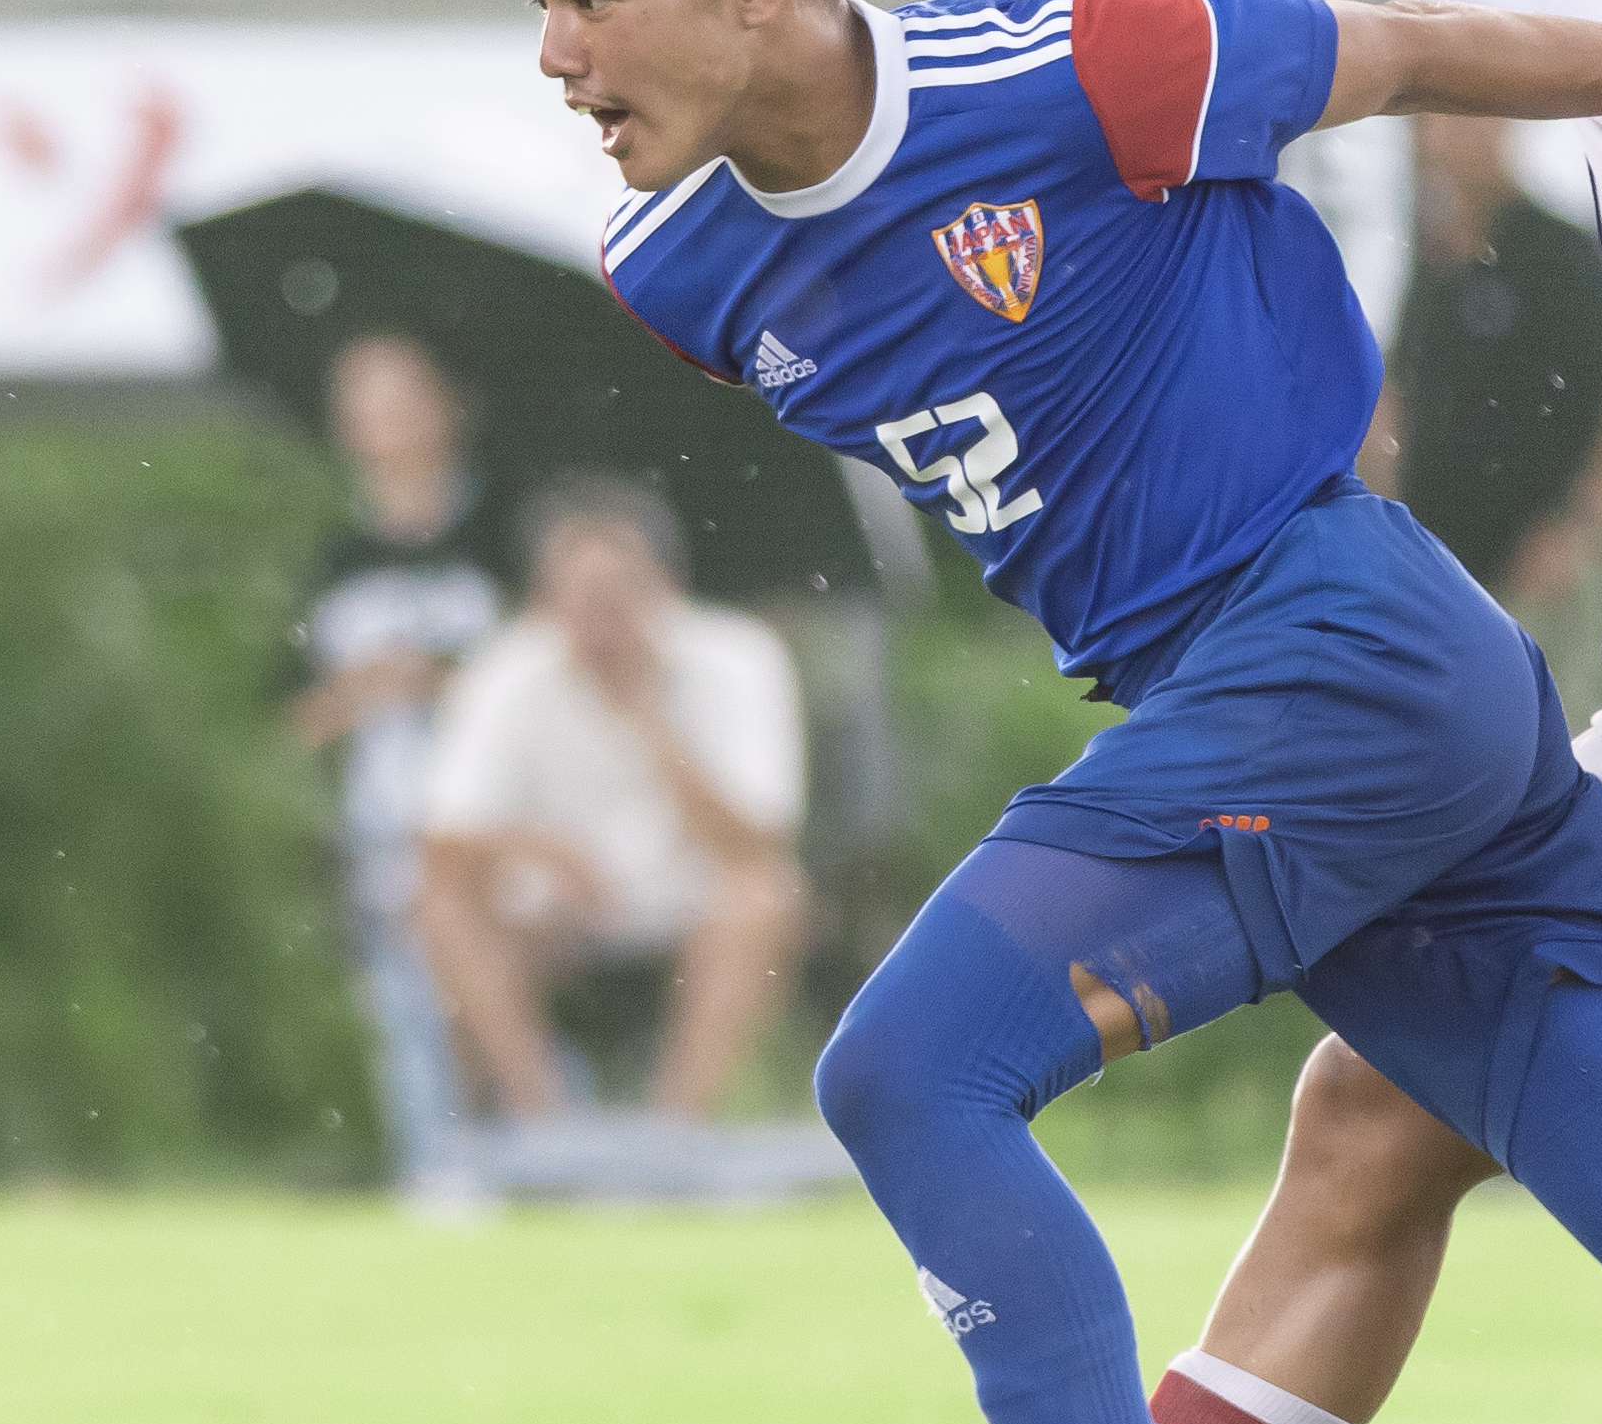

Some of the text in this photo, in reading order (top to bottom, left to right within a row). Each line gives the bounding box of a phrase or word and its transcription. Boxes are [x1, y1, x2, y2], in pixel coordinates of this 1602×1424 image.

[948, 211, 1032, 254] JAPAN
[1015, 235, 1037, 294] NIIGATA
[758, 358, 818, 387] adidas
[875, 391, 1044, 534] 52
